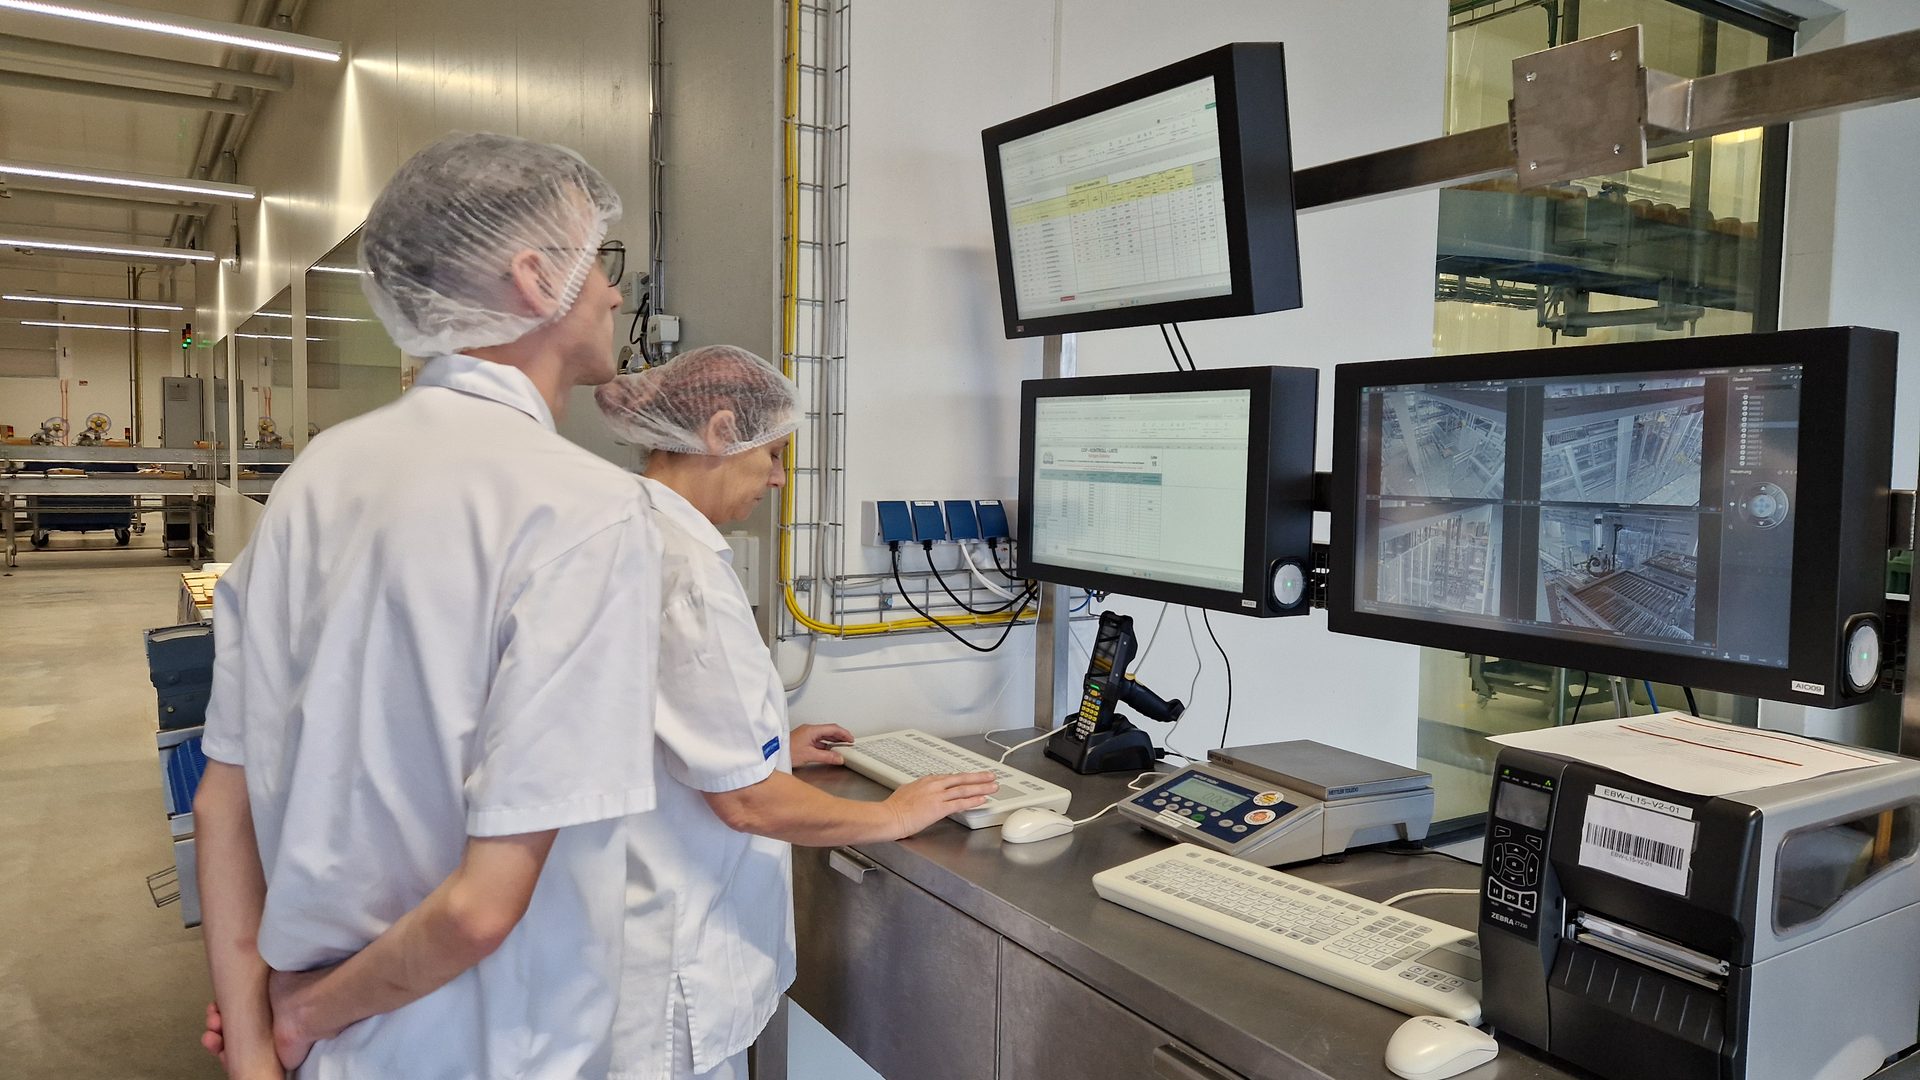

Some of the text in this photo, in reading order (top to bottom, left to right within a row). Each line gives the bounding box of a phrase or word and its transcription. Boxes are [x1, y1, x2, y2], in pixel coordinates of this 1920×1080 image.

[1795, 682, 1822, 693] AIO09
[1603, 788, 1680, 814] EBW-L15-V2-01
[1491, 911, 1514, 926] ZEBRA
